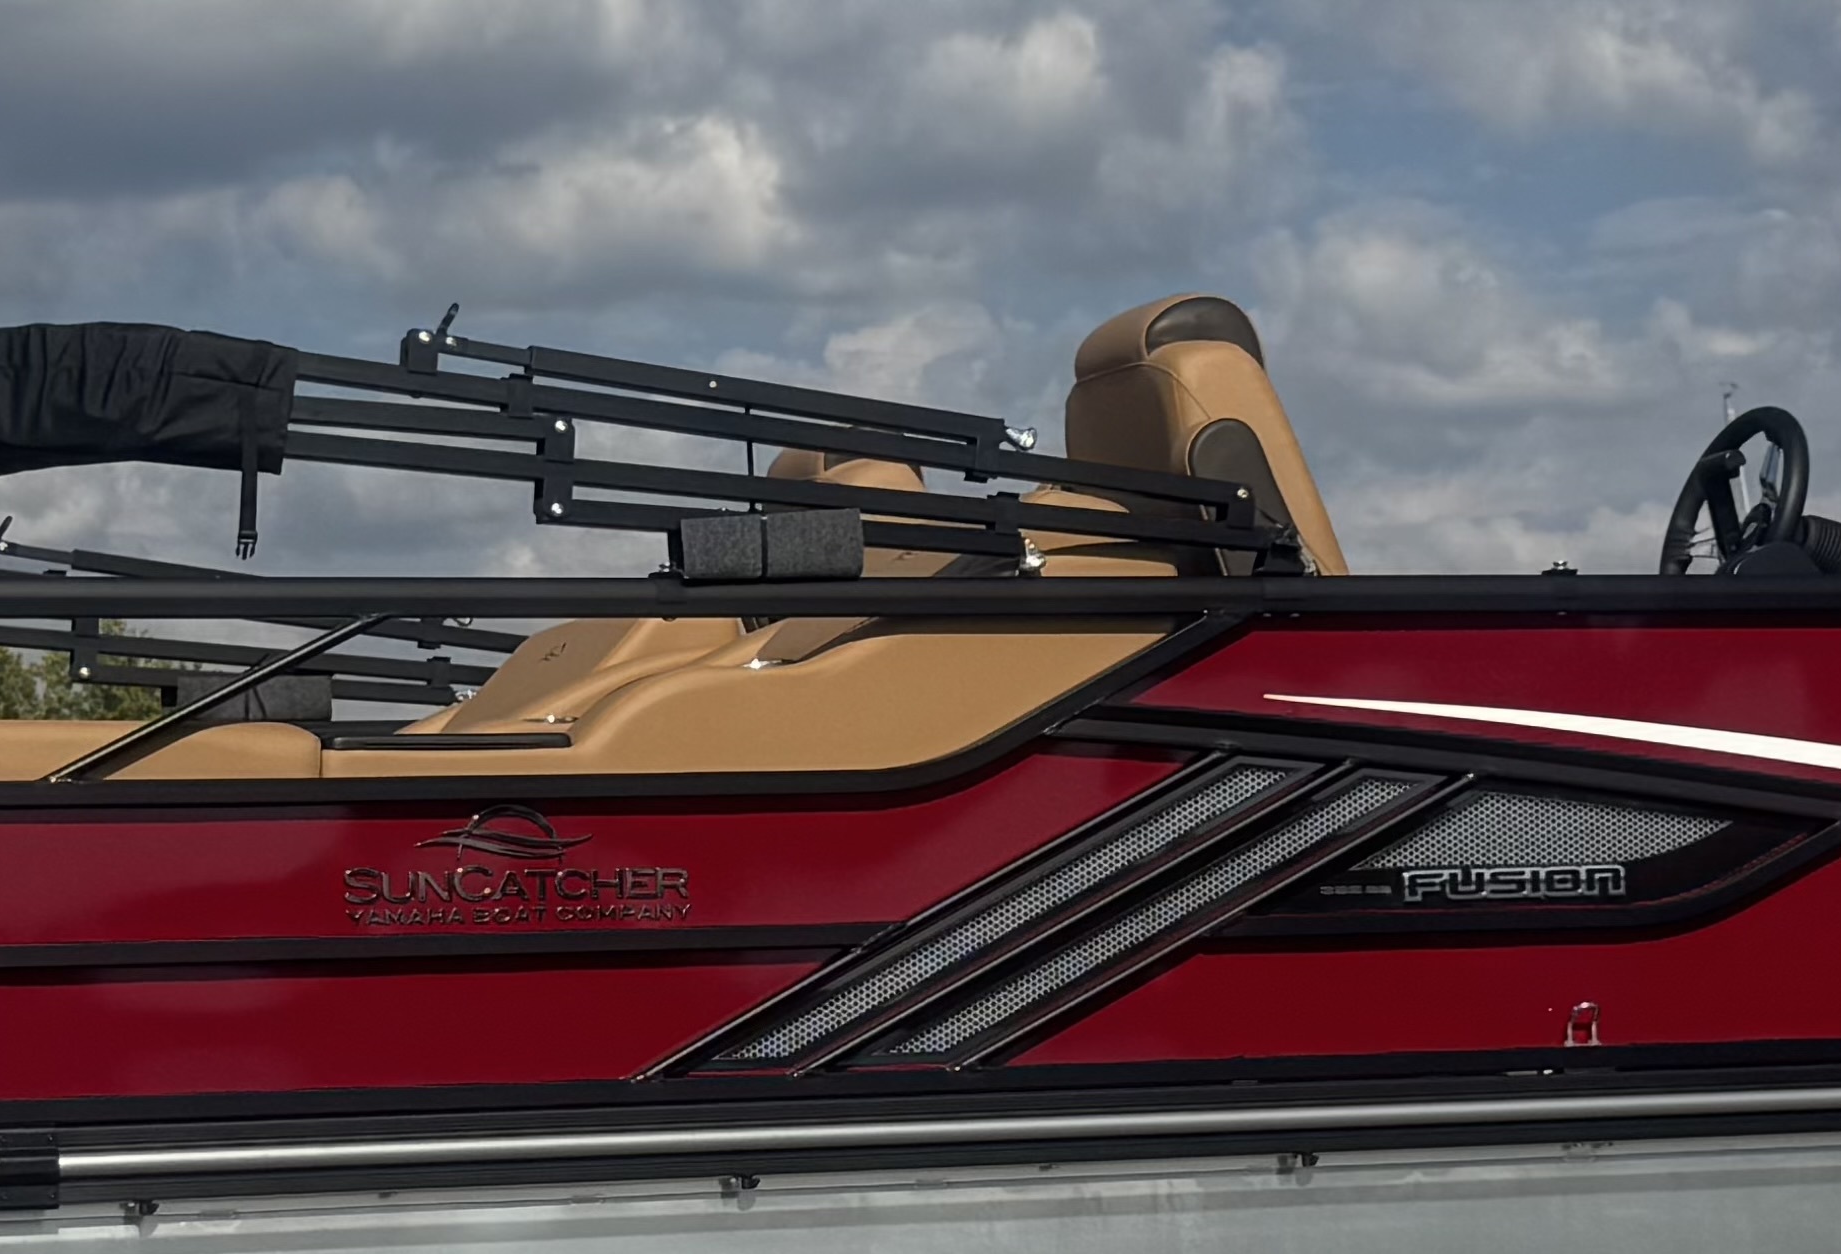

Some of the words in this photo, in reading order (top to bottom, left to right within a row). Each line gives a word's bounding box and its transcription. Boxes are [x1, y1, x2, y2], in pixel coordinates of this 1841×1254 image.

[345, 908, 465, 927] YAMAHA
[472, 905, 548, 925] BOAT
[555, 902, 692, 923] COMPANY
